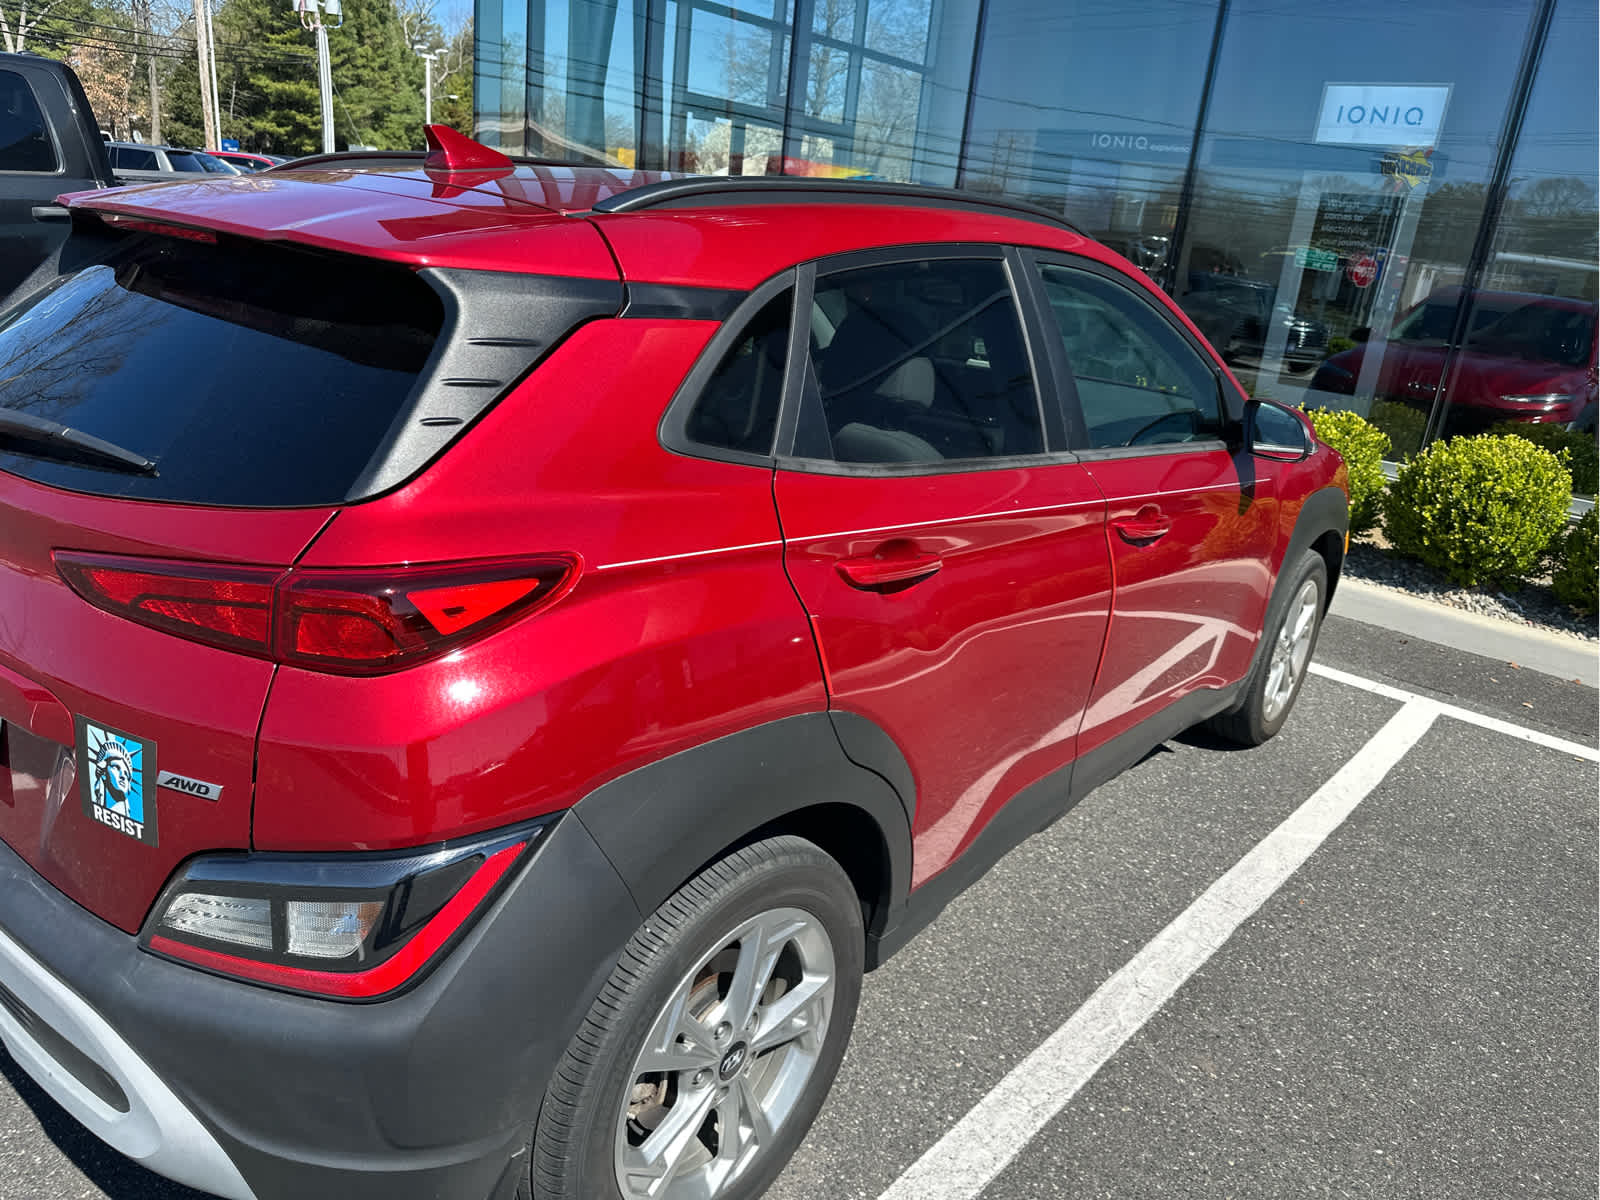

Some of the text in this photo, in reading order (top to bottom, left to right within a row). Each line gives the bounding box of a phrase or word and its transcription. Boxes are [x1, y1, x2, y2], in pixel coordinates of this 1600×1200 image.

[1336, 105, 1424, 126] IONIQ
[1091, 133, 1148, 150] IONIQ
[164, 777, 210, 796] AWD
[93, 804, 144, 839] RESIST
